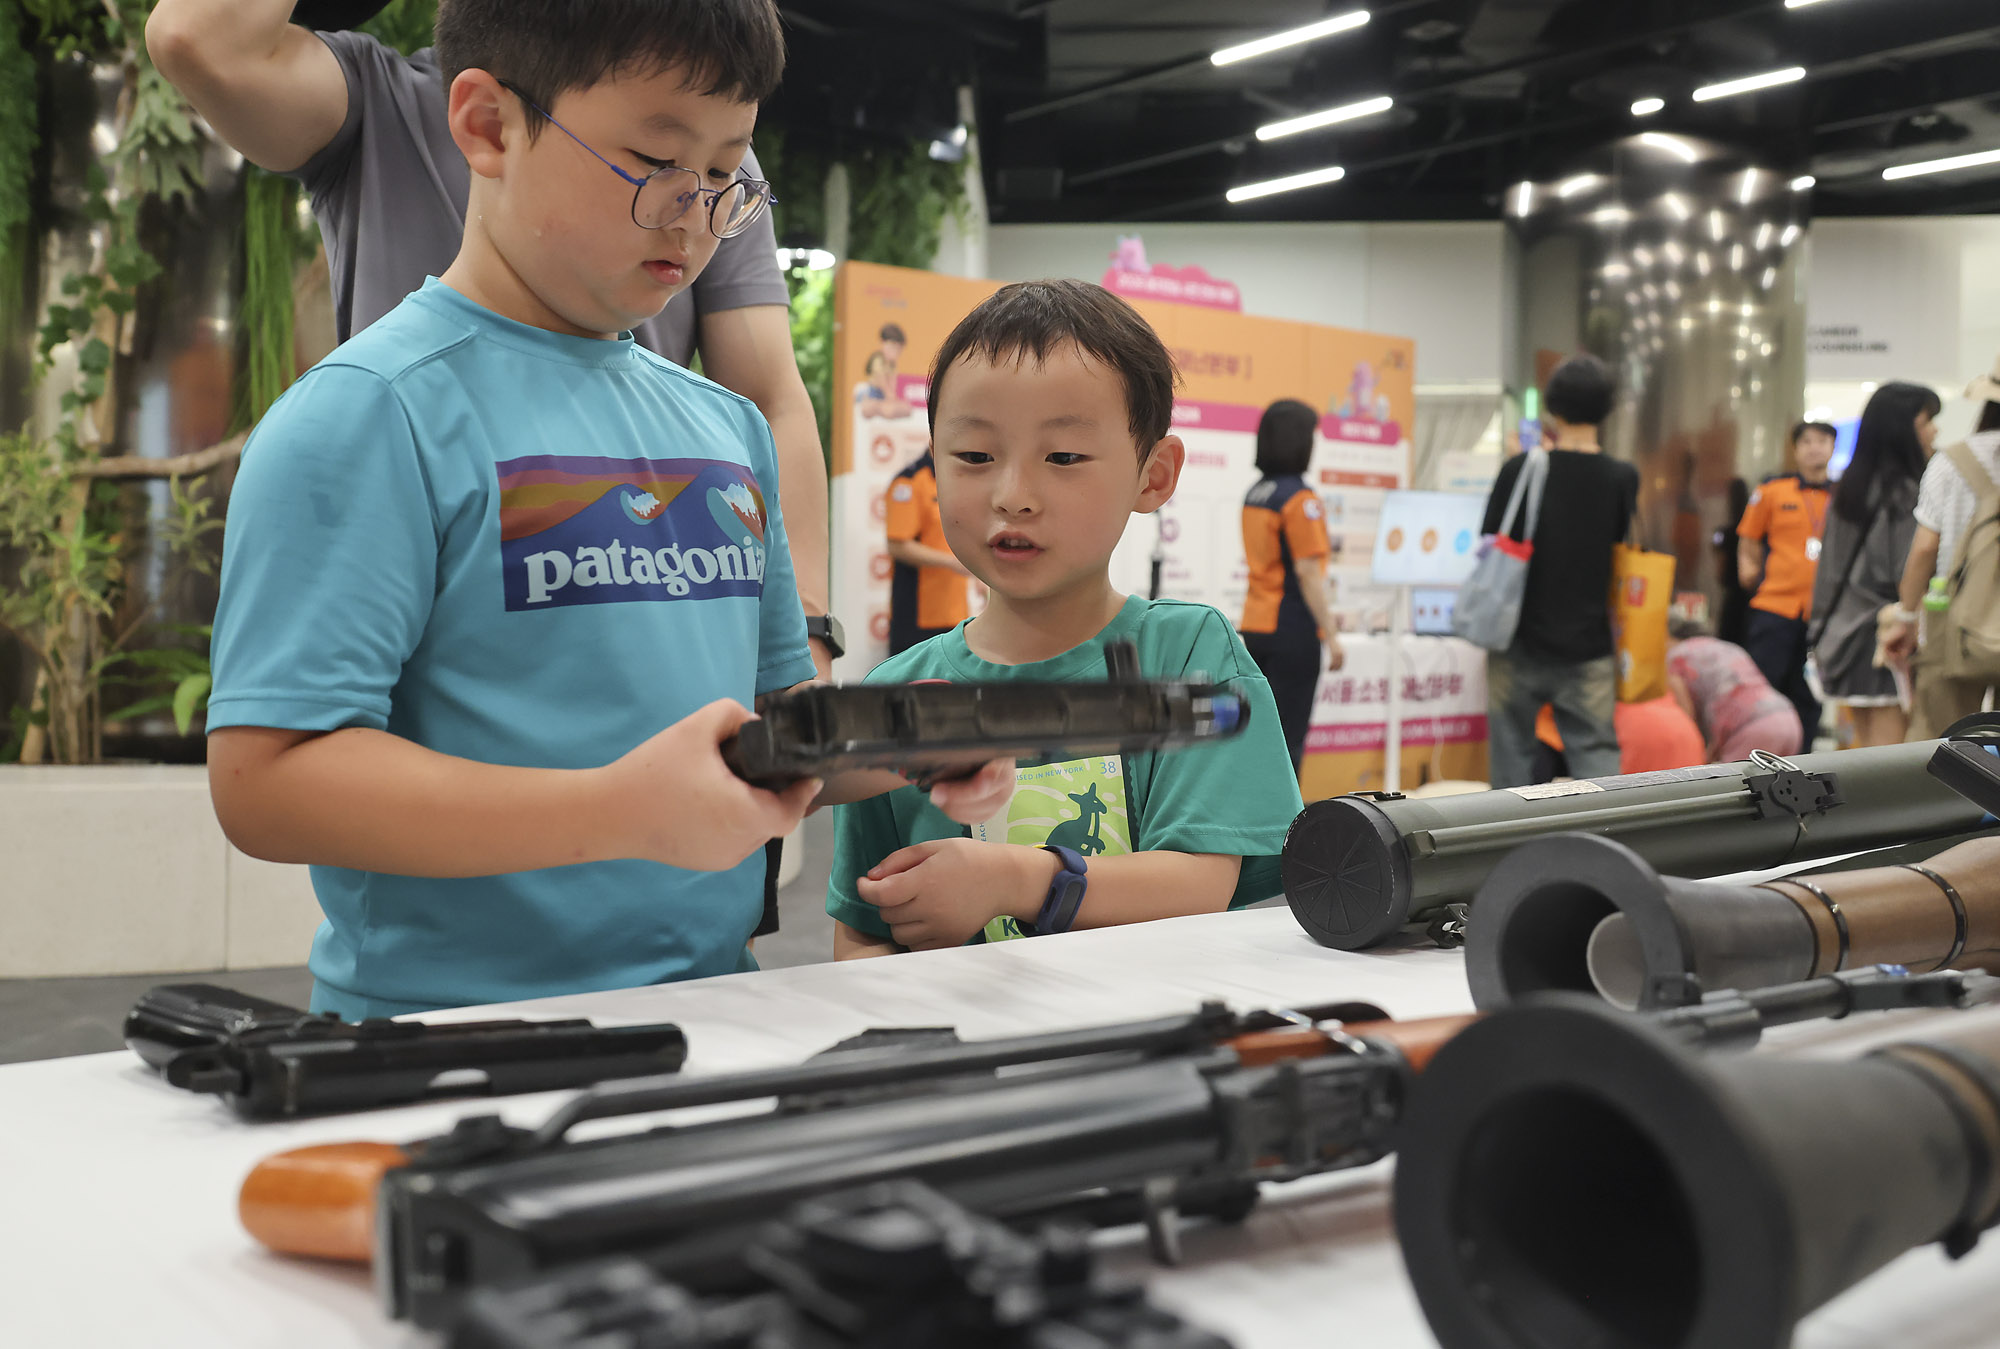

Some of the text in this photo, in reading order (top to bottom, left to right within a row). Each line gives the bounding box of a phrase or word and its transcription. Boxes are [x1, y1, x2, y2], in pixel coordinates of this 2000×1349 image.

[1016, 773, 1033, 781] ISED
[1045, 769, 1062, 777] NEW
[1063, 766, 1084, 775] YORK
[1099, 761, 1116, 775] 38
